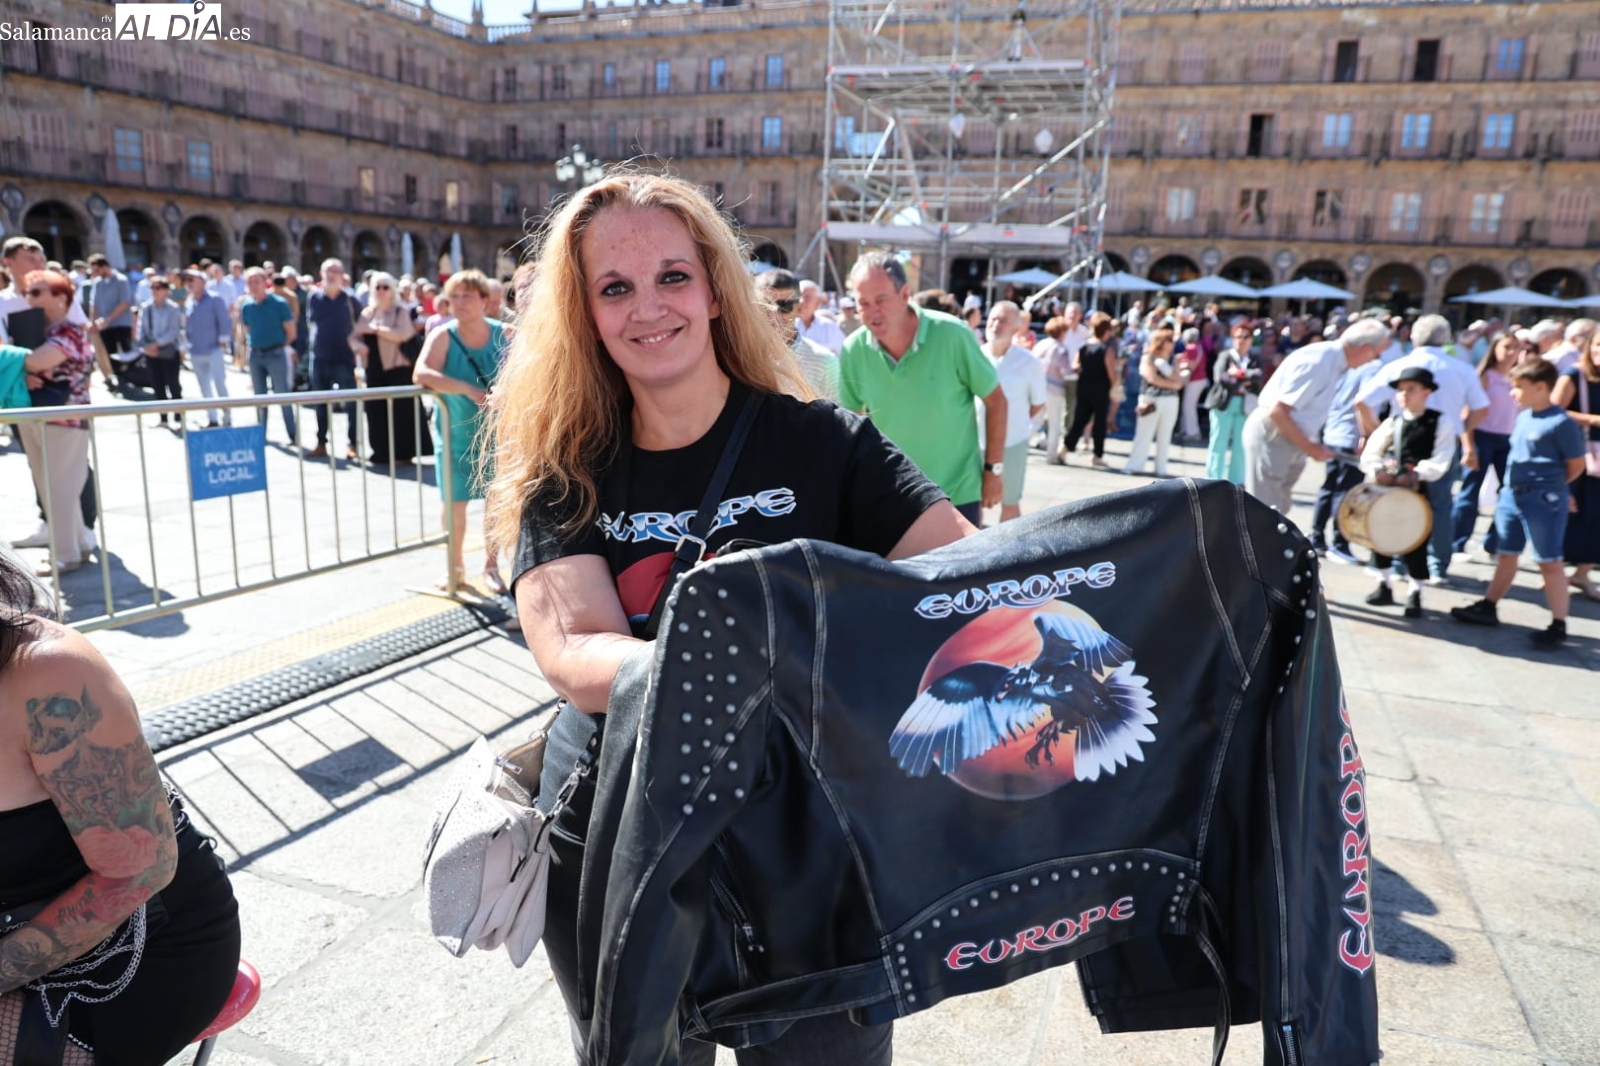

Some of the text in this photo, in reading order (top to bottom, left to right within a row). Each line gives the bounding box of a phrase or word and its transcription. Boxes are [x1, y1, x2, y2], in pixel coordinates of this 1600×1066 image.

[208, 466, 254, 484] LOCAL
[914, 561, 1116, 619] EUROPE
[944, 896, 1135, 970] EUROPE
